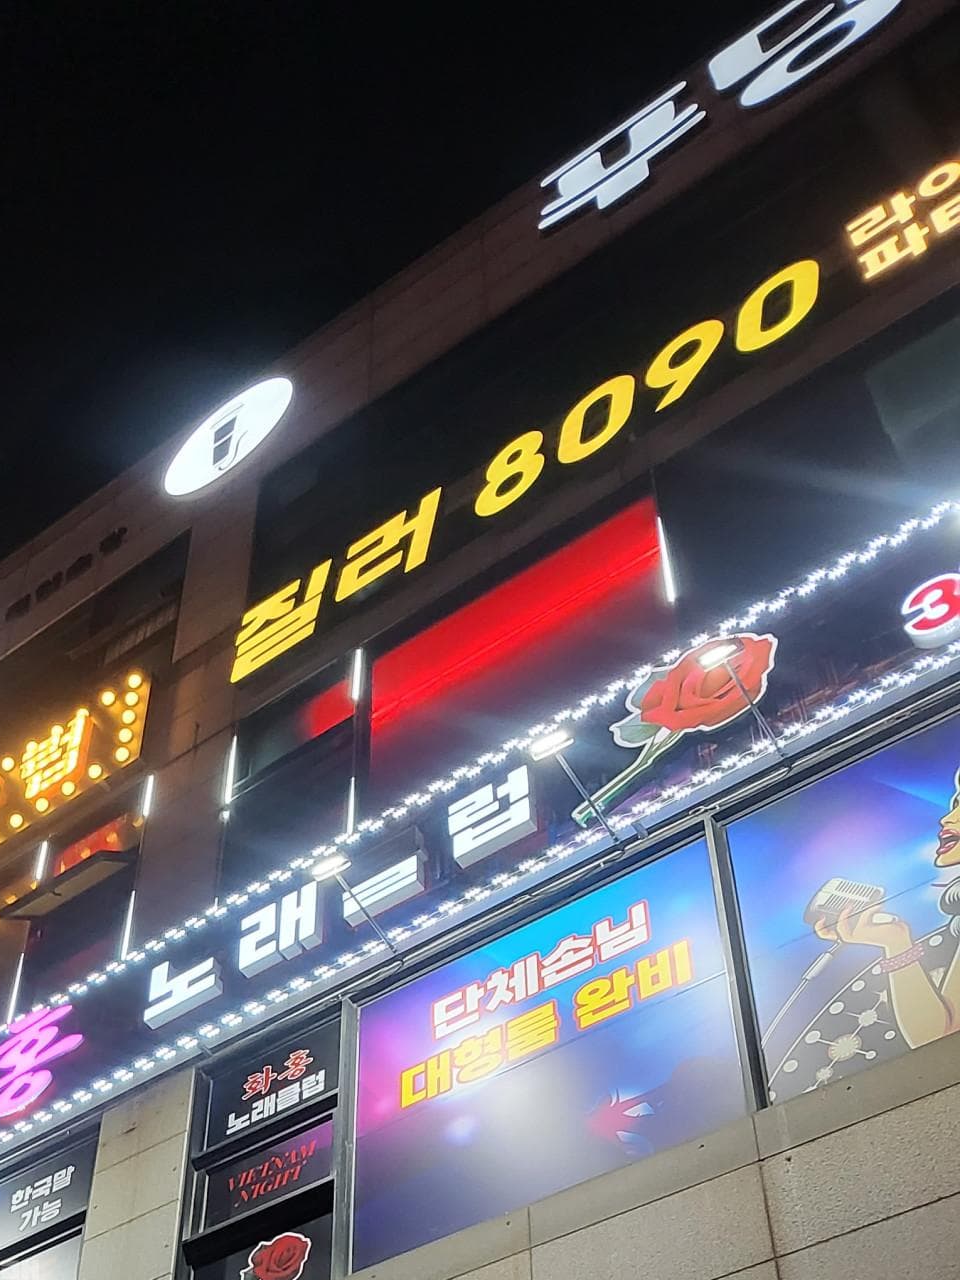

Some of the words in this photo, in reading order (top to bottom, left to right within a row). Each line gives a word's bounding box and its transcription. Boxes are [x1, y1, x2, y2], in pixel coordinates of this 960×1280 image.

[230, 487, 441, 683] 질러
[475, 259, 819, 517] 8090
[432, 899, 650, 1041] 단체손님
[399, 1000, 560, 1110] 대형룸
[575, 938, 695, 1031] 완비
[241, 1049, 315, 1101] 화홍
[226, 1068, 327, 1136] 노래클럽
[10, 1165, 76, 1213] 한국말
[228, 1139, 318, 1192] VIETNAM
[233, 1159, 310, 1209] NIGHT
[18, 1198, 63, 1232] 가능
